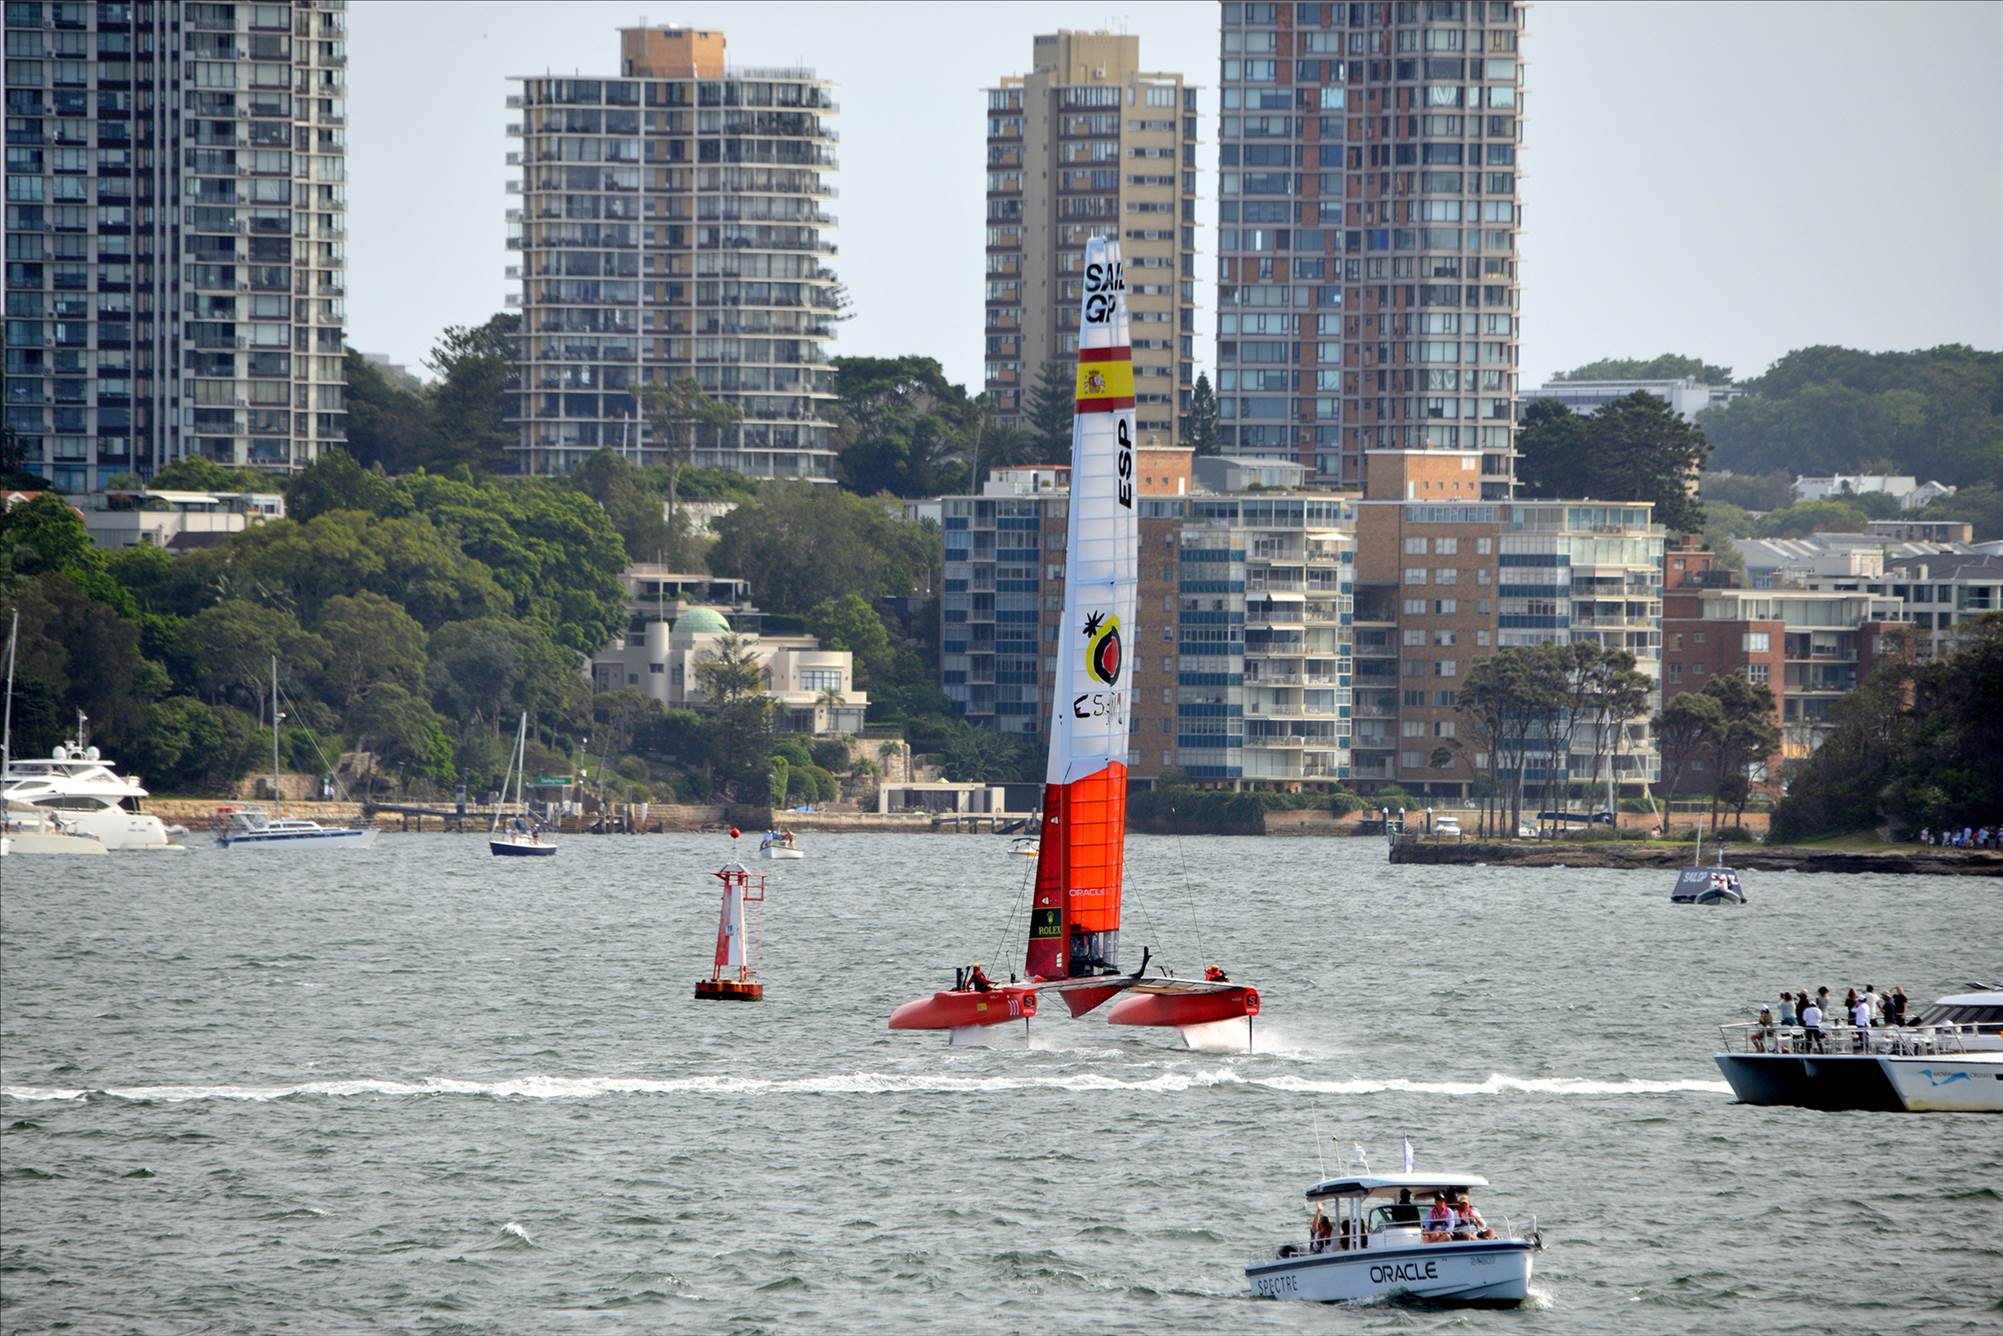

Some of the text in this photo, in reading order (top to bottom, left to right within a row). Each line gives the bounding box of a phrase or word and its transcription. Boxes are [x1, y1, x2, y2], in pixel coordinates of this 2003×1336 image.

[1086, 293, 1116, 323] GP
[1117, 418, 1132, 510] ESP
[1257, 1275, 1298, 1296] SPECTRE
[1370, 1261, 1438, 1284] ORACLE
